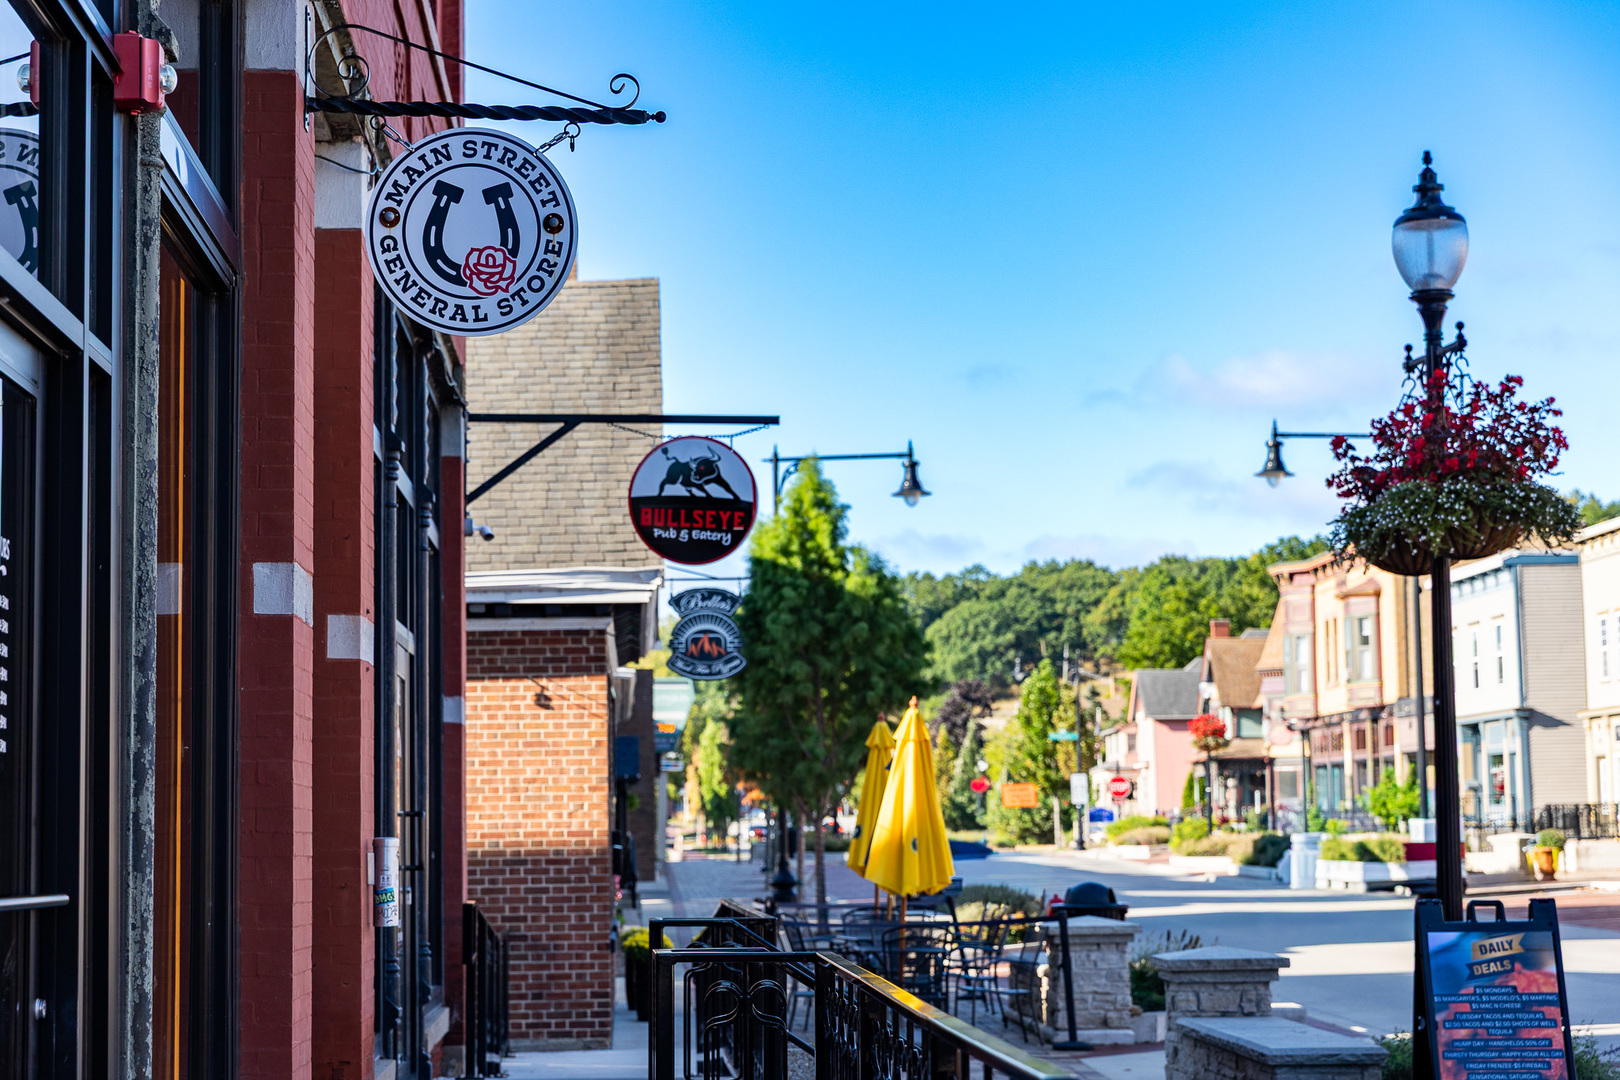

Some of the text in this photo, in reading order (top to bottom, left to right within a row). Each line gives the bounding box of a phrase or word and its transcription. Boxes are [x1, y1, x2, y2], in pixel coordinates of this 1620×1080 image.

[384, 139, 560, 208] MAIN STREET
[379, 235, 564, 323] GENERAL STORE
[640, 507, 745, 530] BULLSEYE
[653, 528, 678, 540] Pub
[691, 530, 732, 546] Eatery
[1109, 783, 1129, 792] STOP
[1478, 939, 1514, 956] DAILY
[1473, 959, 1512, 976] DEALS
